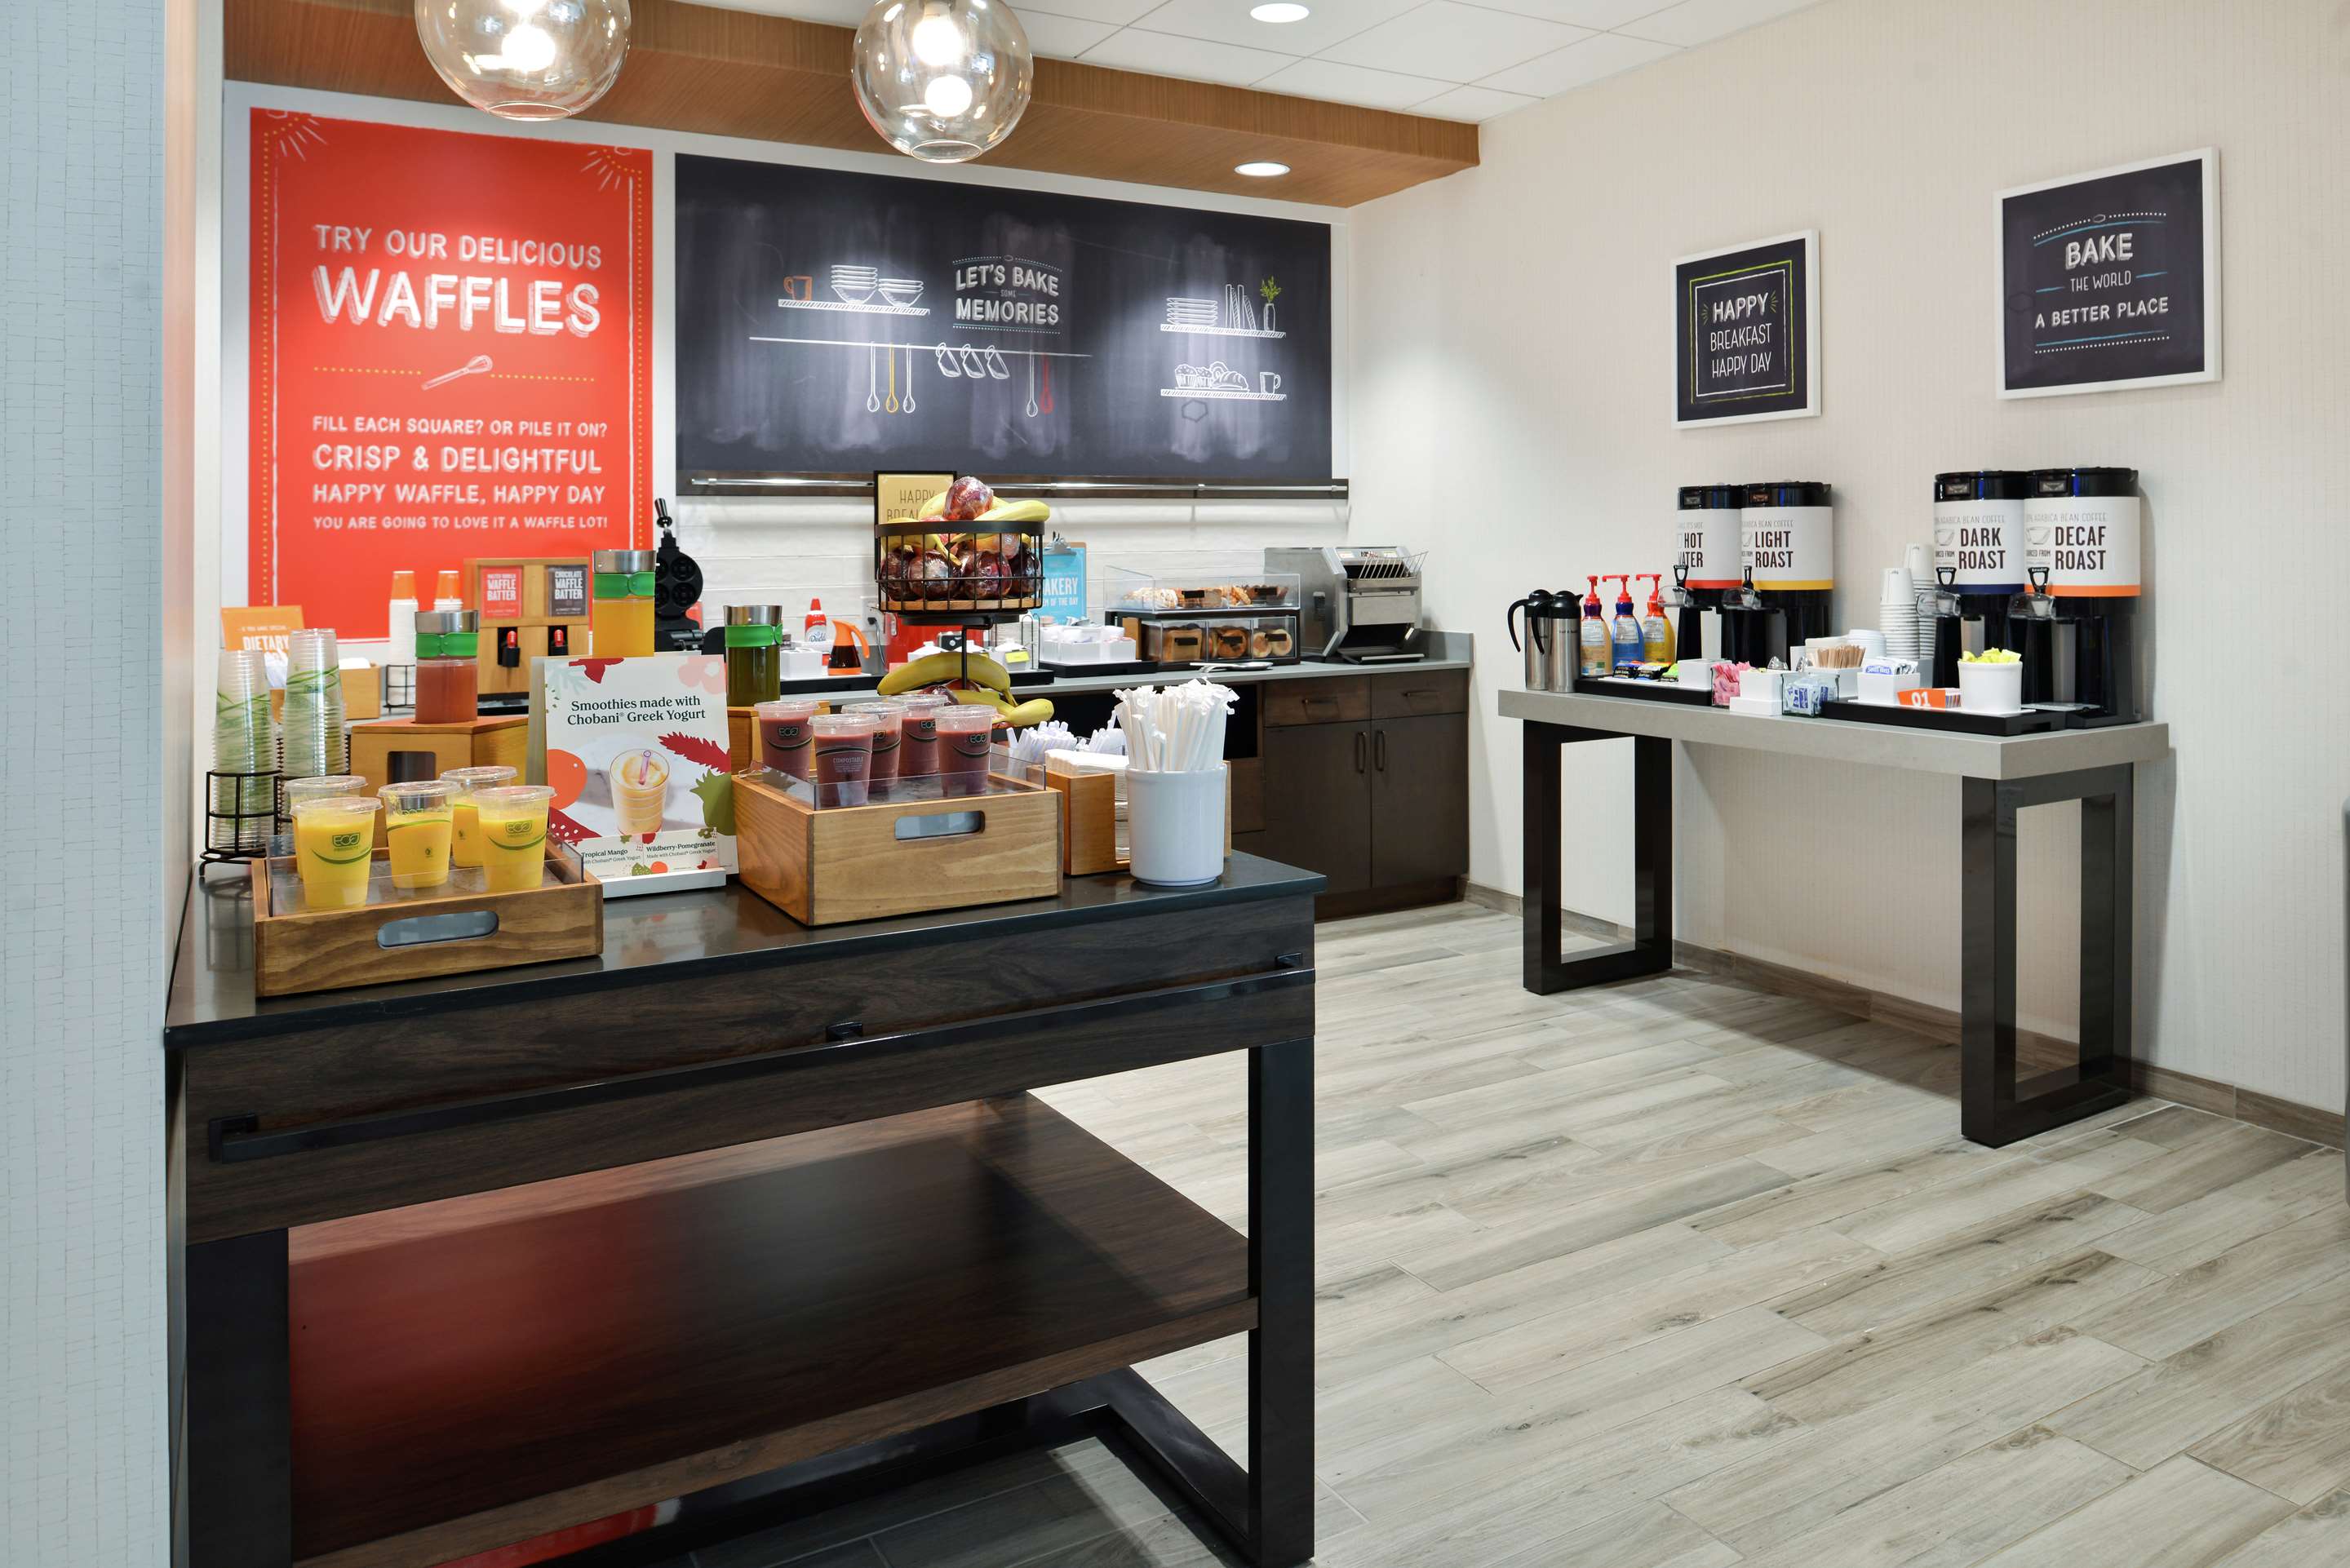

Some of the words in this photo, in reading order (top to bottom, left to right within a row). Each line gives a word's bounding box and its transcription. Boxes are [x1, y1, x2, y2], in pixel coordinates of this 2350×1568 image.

[312, 224, 372, 252] TRY
[385, 229, 448, 259] OUR
[458, 235, 601, 270] DELICIOUS
[2065, 233, 2133, 270] BAKE
[956, 264, 1005, 291] LET'S
[1012, 266, 1059, 297] BAKE
[2070, 276, 2089, 293] THE
[2093, 270, 2131, 290] WORLD
[312, 265, 601, 338] WAFFLES
[1713, 292, 1769, 324] HAPPY
[956, 298, 1059, 326] MEMORIES
[2035, 313, 2045, 329] A
[2051, 304, 2110, 327] BETTER
[2117, 296, 2169, 319] PLACE
[1710, 322, 1772, 352] BREAKFAST
[1712, 355, 1748, 379] HAPPY
[1751, 352, 1772, 374] DAY
[313, 416, 348, 432] FILL
[354, 417, 400, 432] EACH
[407, 418, 483, 434] SQUARE?
[490, 420, 513, 435] OR
[519, 421, 552, 436] PILE
[557, 422, 571, 436] IT
[577, 423, 608, 437] ON?
[313, 444, 401, 471] CRISP
[412, 445, 429, 471] &
[441, 446, 601, 474] DELIGHTFUL
[313, 484, 386, 503] HAPPY
[395, 484, 486, 505] WAFFLE,
[494, 485, 560, 504] HAPPY
[567, 485, 605, 504] DAY
[899, 489, 935, 503] HAPPY
[313, 516, 343, 529] YOU
[348, 516, 377, 529] ARE
[382, 516, 427, 529] GOING
[432, 516, 450, 529] TO
[454, 516, 489, 529] LOVE
[493, 516, 505, 529] IT
[509, 516, 519, 529] A
[524, 516, 575, 529] WAFFLE
[579, 516, 608, 529] LOT!
[1684, 533, 1703, 548] HOT
[1755, 531, 1791, 547] LIGHT
[1961, 528, 2002, 547] DARK
[2055, 526, 2106, 546] DECAF
[1755, 551, 1794, 568] ROAST
[1958, 550, 2006, 569] ROAST
[2055, 550, 2106, 569] ROAST
[487, 578, 516, 589] WAFFLE
[555, 578, 583, 588] WAFFLE
[1043, 578, 1078, 596] AKERY
[487, 590, 516, 600] BATTER
[555, 589, 583, 600] BATTER
[242, 635, 289, 651] DIETARY
[571, 699, 636, 711] Smoothies
[640, 697, 672, 708] made
[675, 695, 700, 706] with
[627, 711, 663, 722] Greek
[667, 709, 706, 722] Yogurt
[581, 849, 606, 859] Tropical
[646, 841, 716, 853] Wildberry-Pomegranate
